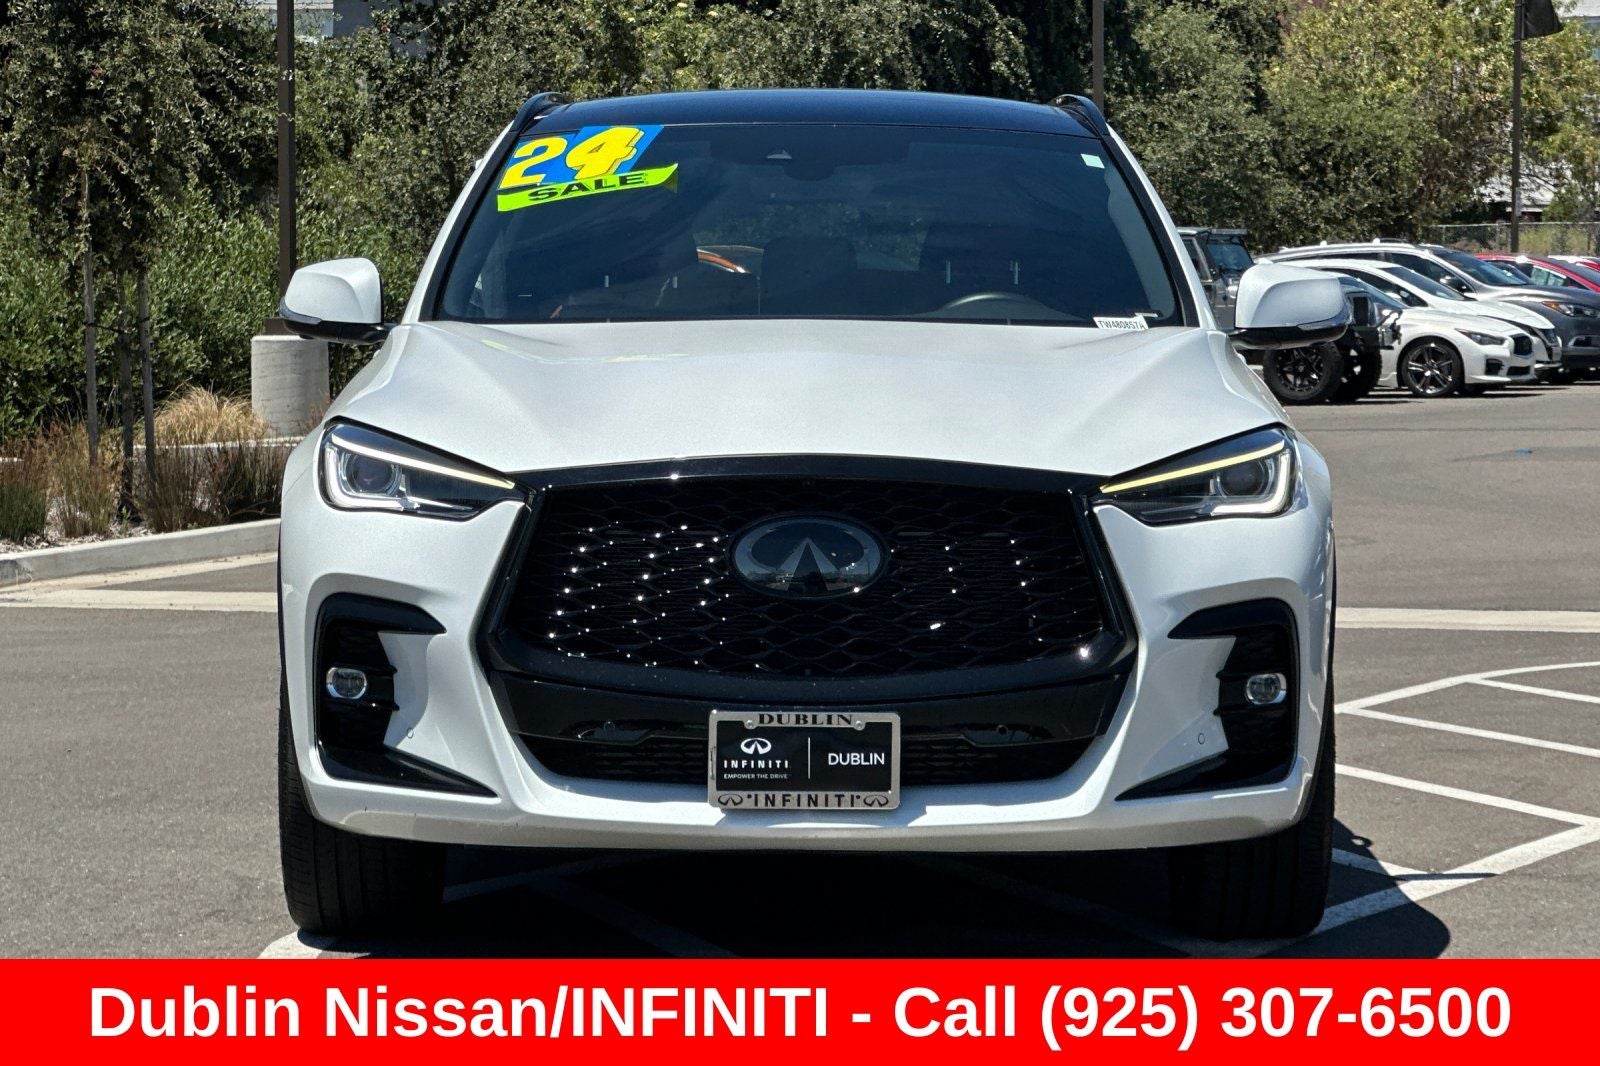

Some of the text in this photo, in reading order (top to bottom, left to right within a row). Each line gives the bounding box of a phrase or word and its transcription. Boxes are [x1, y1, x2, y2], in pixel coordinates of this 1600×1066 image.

[499, 126, 644, 188] 24
[528, 172, 649, 200] SALE
[758, 713, 853, 726] DUBLIN
[723, 759, 789, 769] INFINITI
[828, 752, 885, 766] DUBLIN
